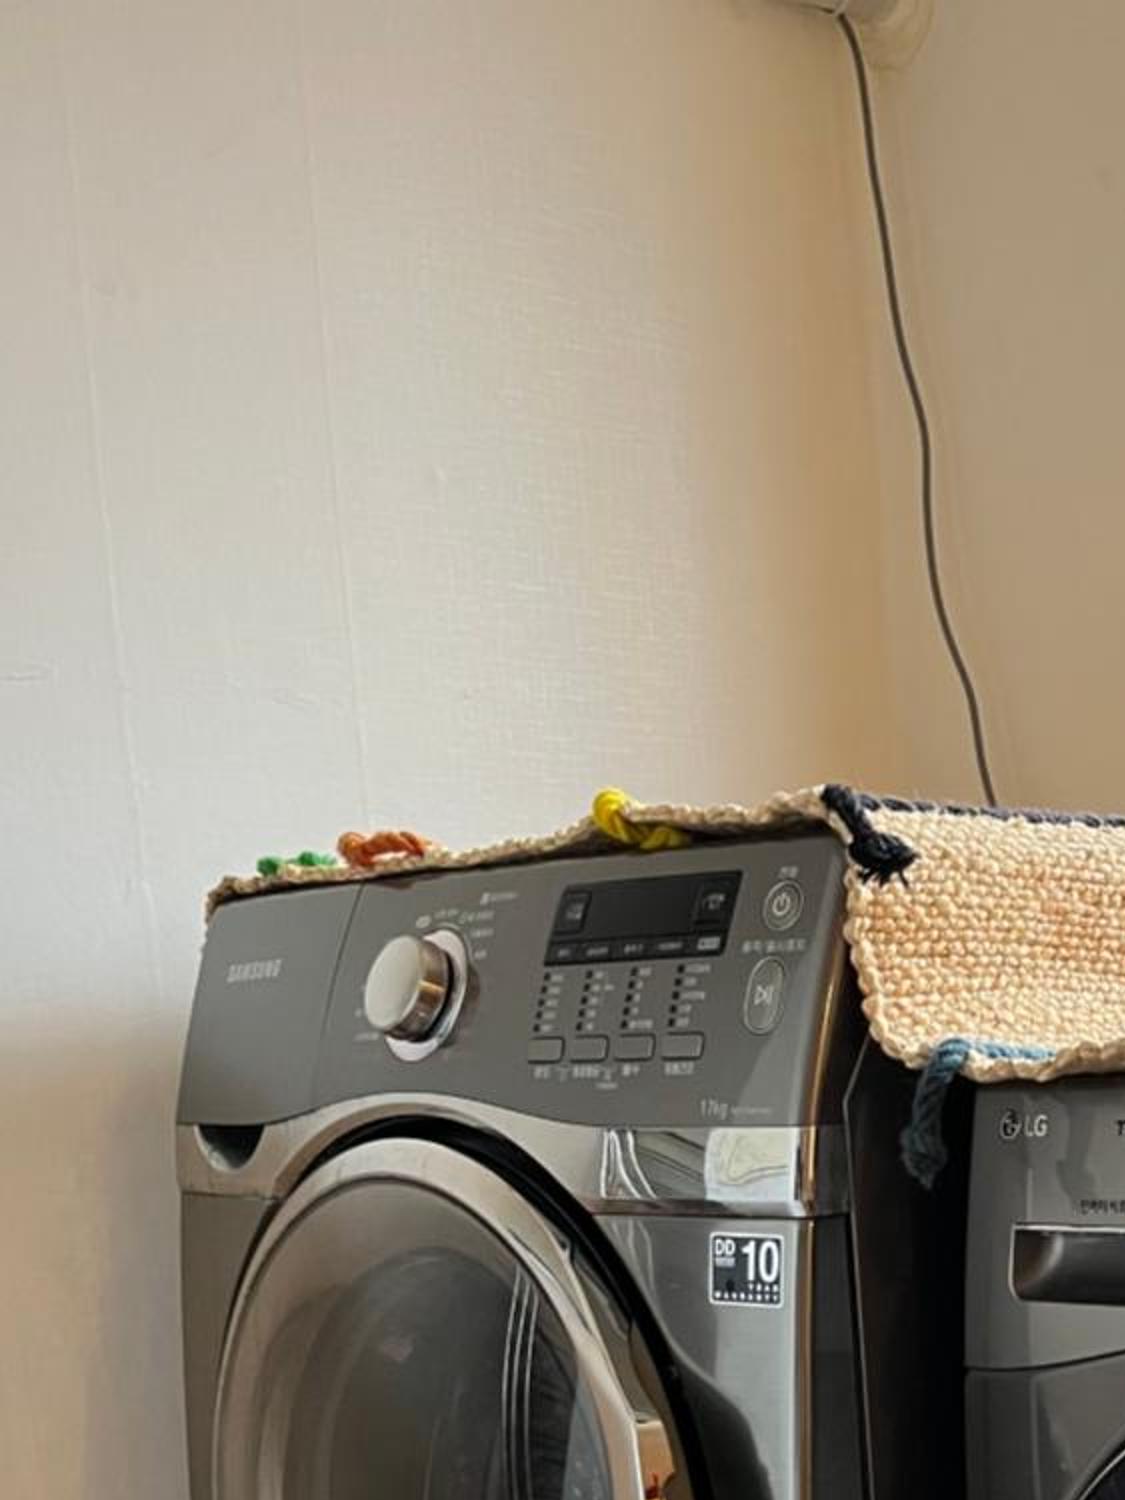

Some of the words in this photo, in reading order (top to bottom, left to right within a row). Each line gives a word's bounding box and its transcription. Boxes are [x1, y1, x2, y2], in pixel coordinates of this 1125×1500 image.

[1024, 1114, 1048, 1137] LG
[715, 1238, 736, 1256] DD
[741, 1239, 779, 1283] 10
